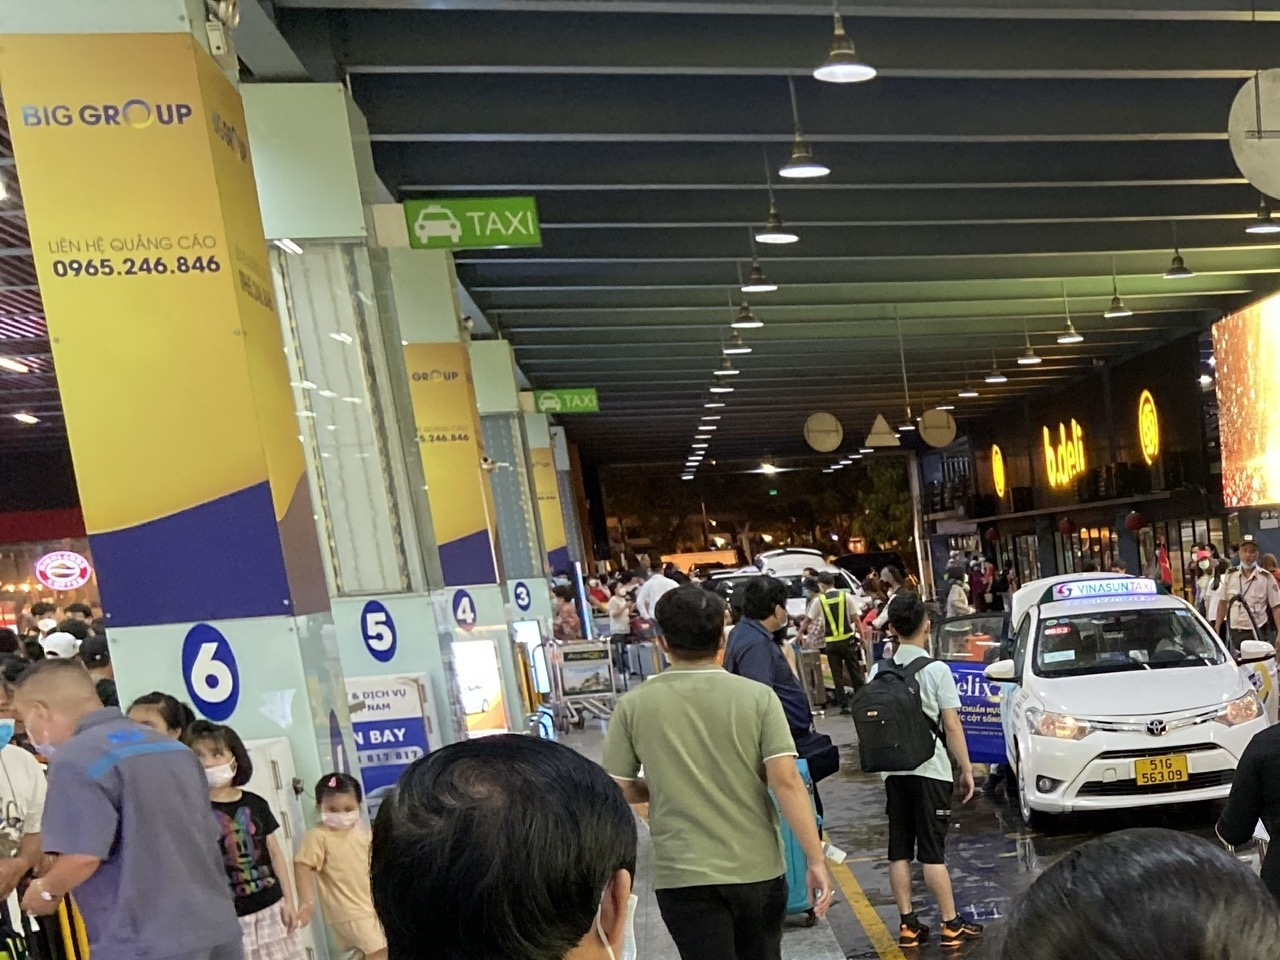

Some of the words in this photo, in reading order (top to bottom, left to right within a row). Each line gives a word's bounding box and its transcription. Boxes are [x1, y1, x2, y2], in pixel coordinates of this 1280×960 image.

[21, 104, 73, 127] BIG
[79, 99, 193, 129] GROUP
[466, 210, 535, 236] TAXI
[48, 237, 81, 254] LIÊN
[85, 235, 104, 255] HỆ
[109, 233, 173, 251] QUẢNG
[177, 232, 217, 249] CÁO
[53, 255, 221, 278] 0965.246.846
[411, 369, 459, 383] GROUP
[562, 394, 597, 408] TAXI
[419, 433, 470, 442] 5.246.846
[1043, 417, 1085, 487] b.deli
[516, 586, 529, 606] 3
[456, 597, 474, 624] 4
[364, 611, 393, 653] 5
[190, 642, 233, 702] 6
[362, 690, 389, 700] DỊCH
[392, 689, 406, 698] VỤ
[367, 703, 391, 711] NAM
[369, 728, 406, 743] BAY
[1150, 758, 1172, 771] 51G
[1142, 770, 1183, 783] 563.09
